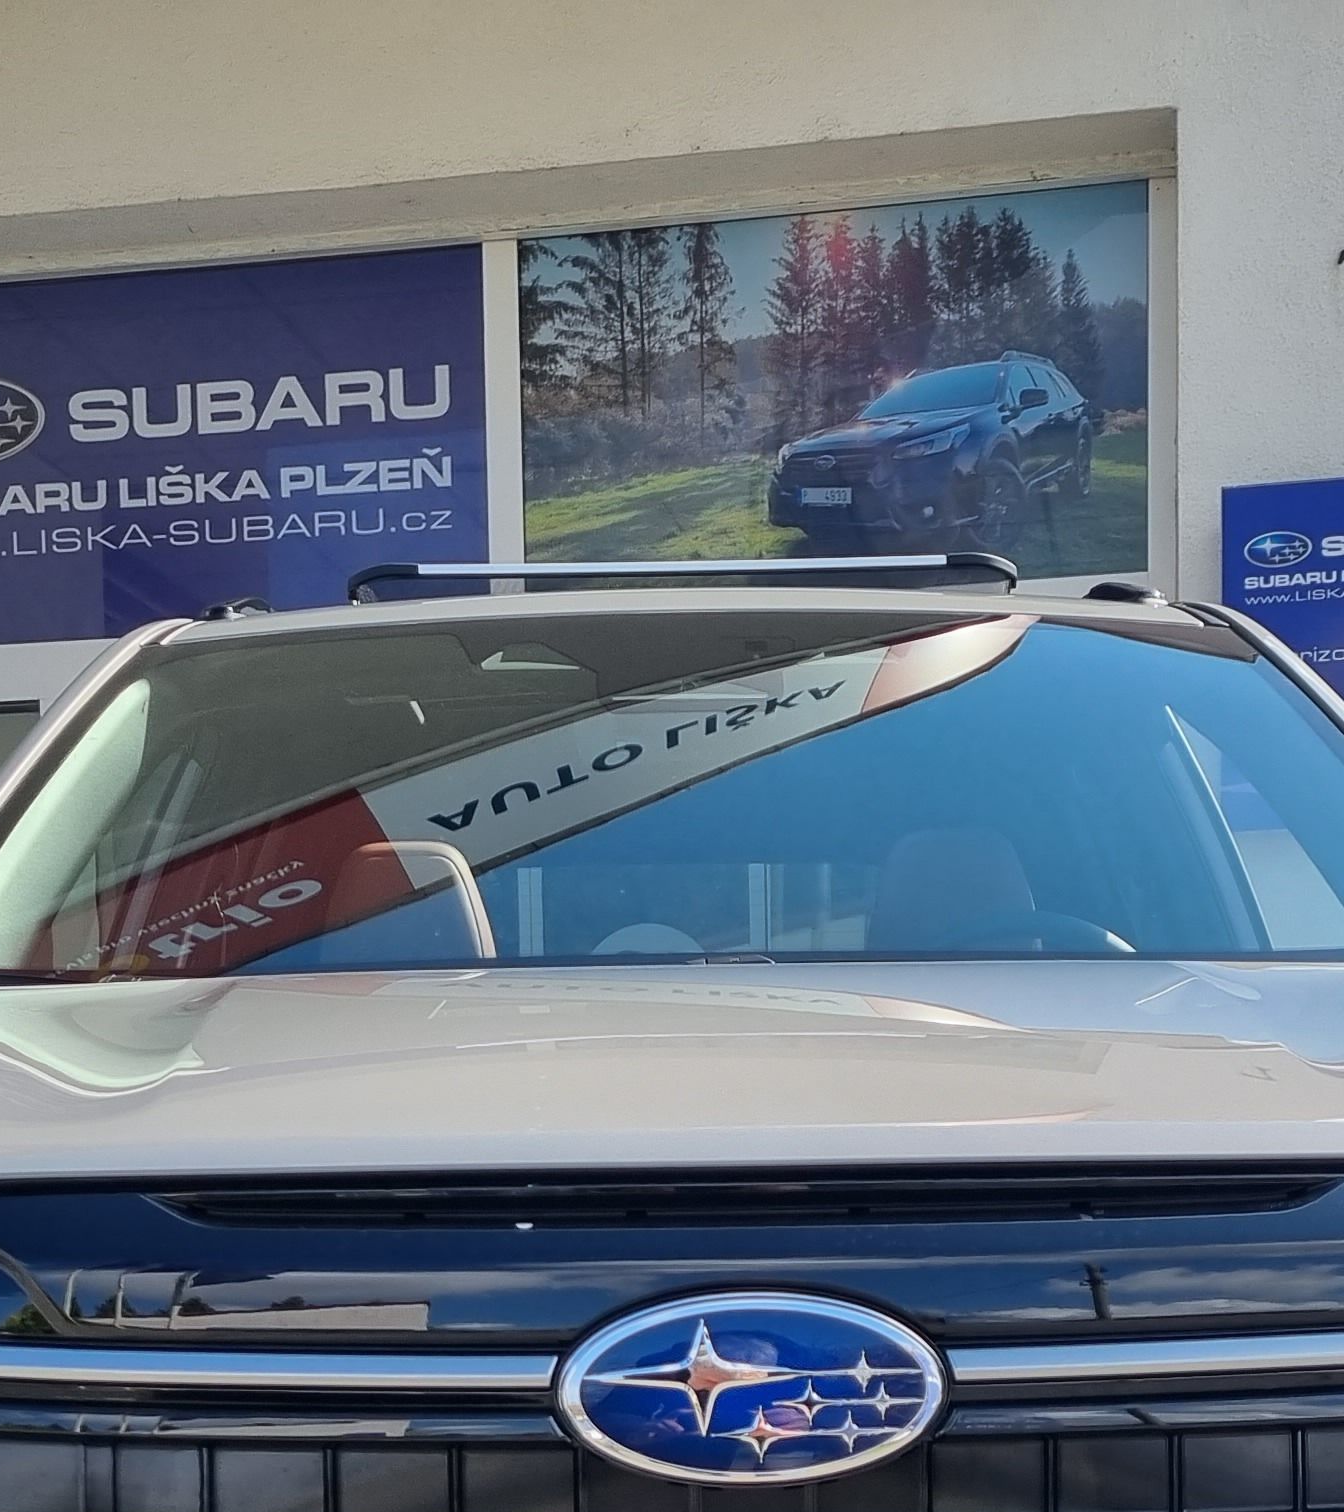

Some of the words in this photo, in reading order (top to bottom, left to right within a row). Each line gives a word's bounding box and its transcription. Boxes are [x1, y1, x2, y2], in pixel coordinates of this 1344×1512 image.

[68, 364, 452, 442] SUBARU
[119, 465, 269, 509] LIŠKA
[280, 446, 453, 498] PLZEŇ
[1244, 570, 1337, 590] SUBARU
